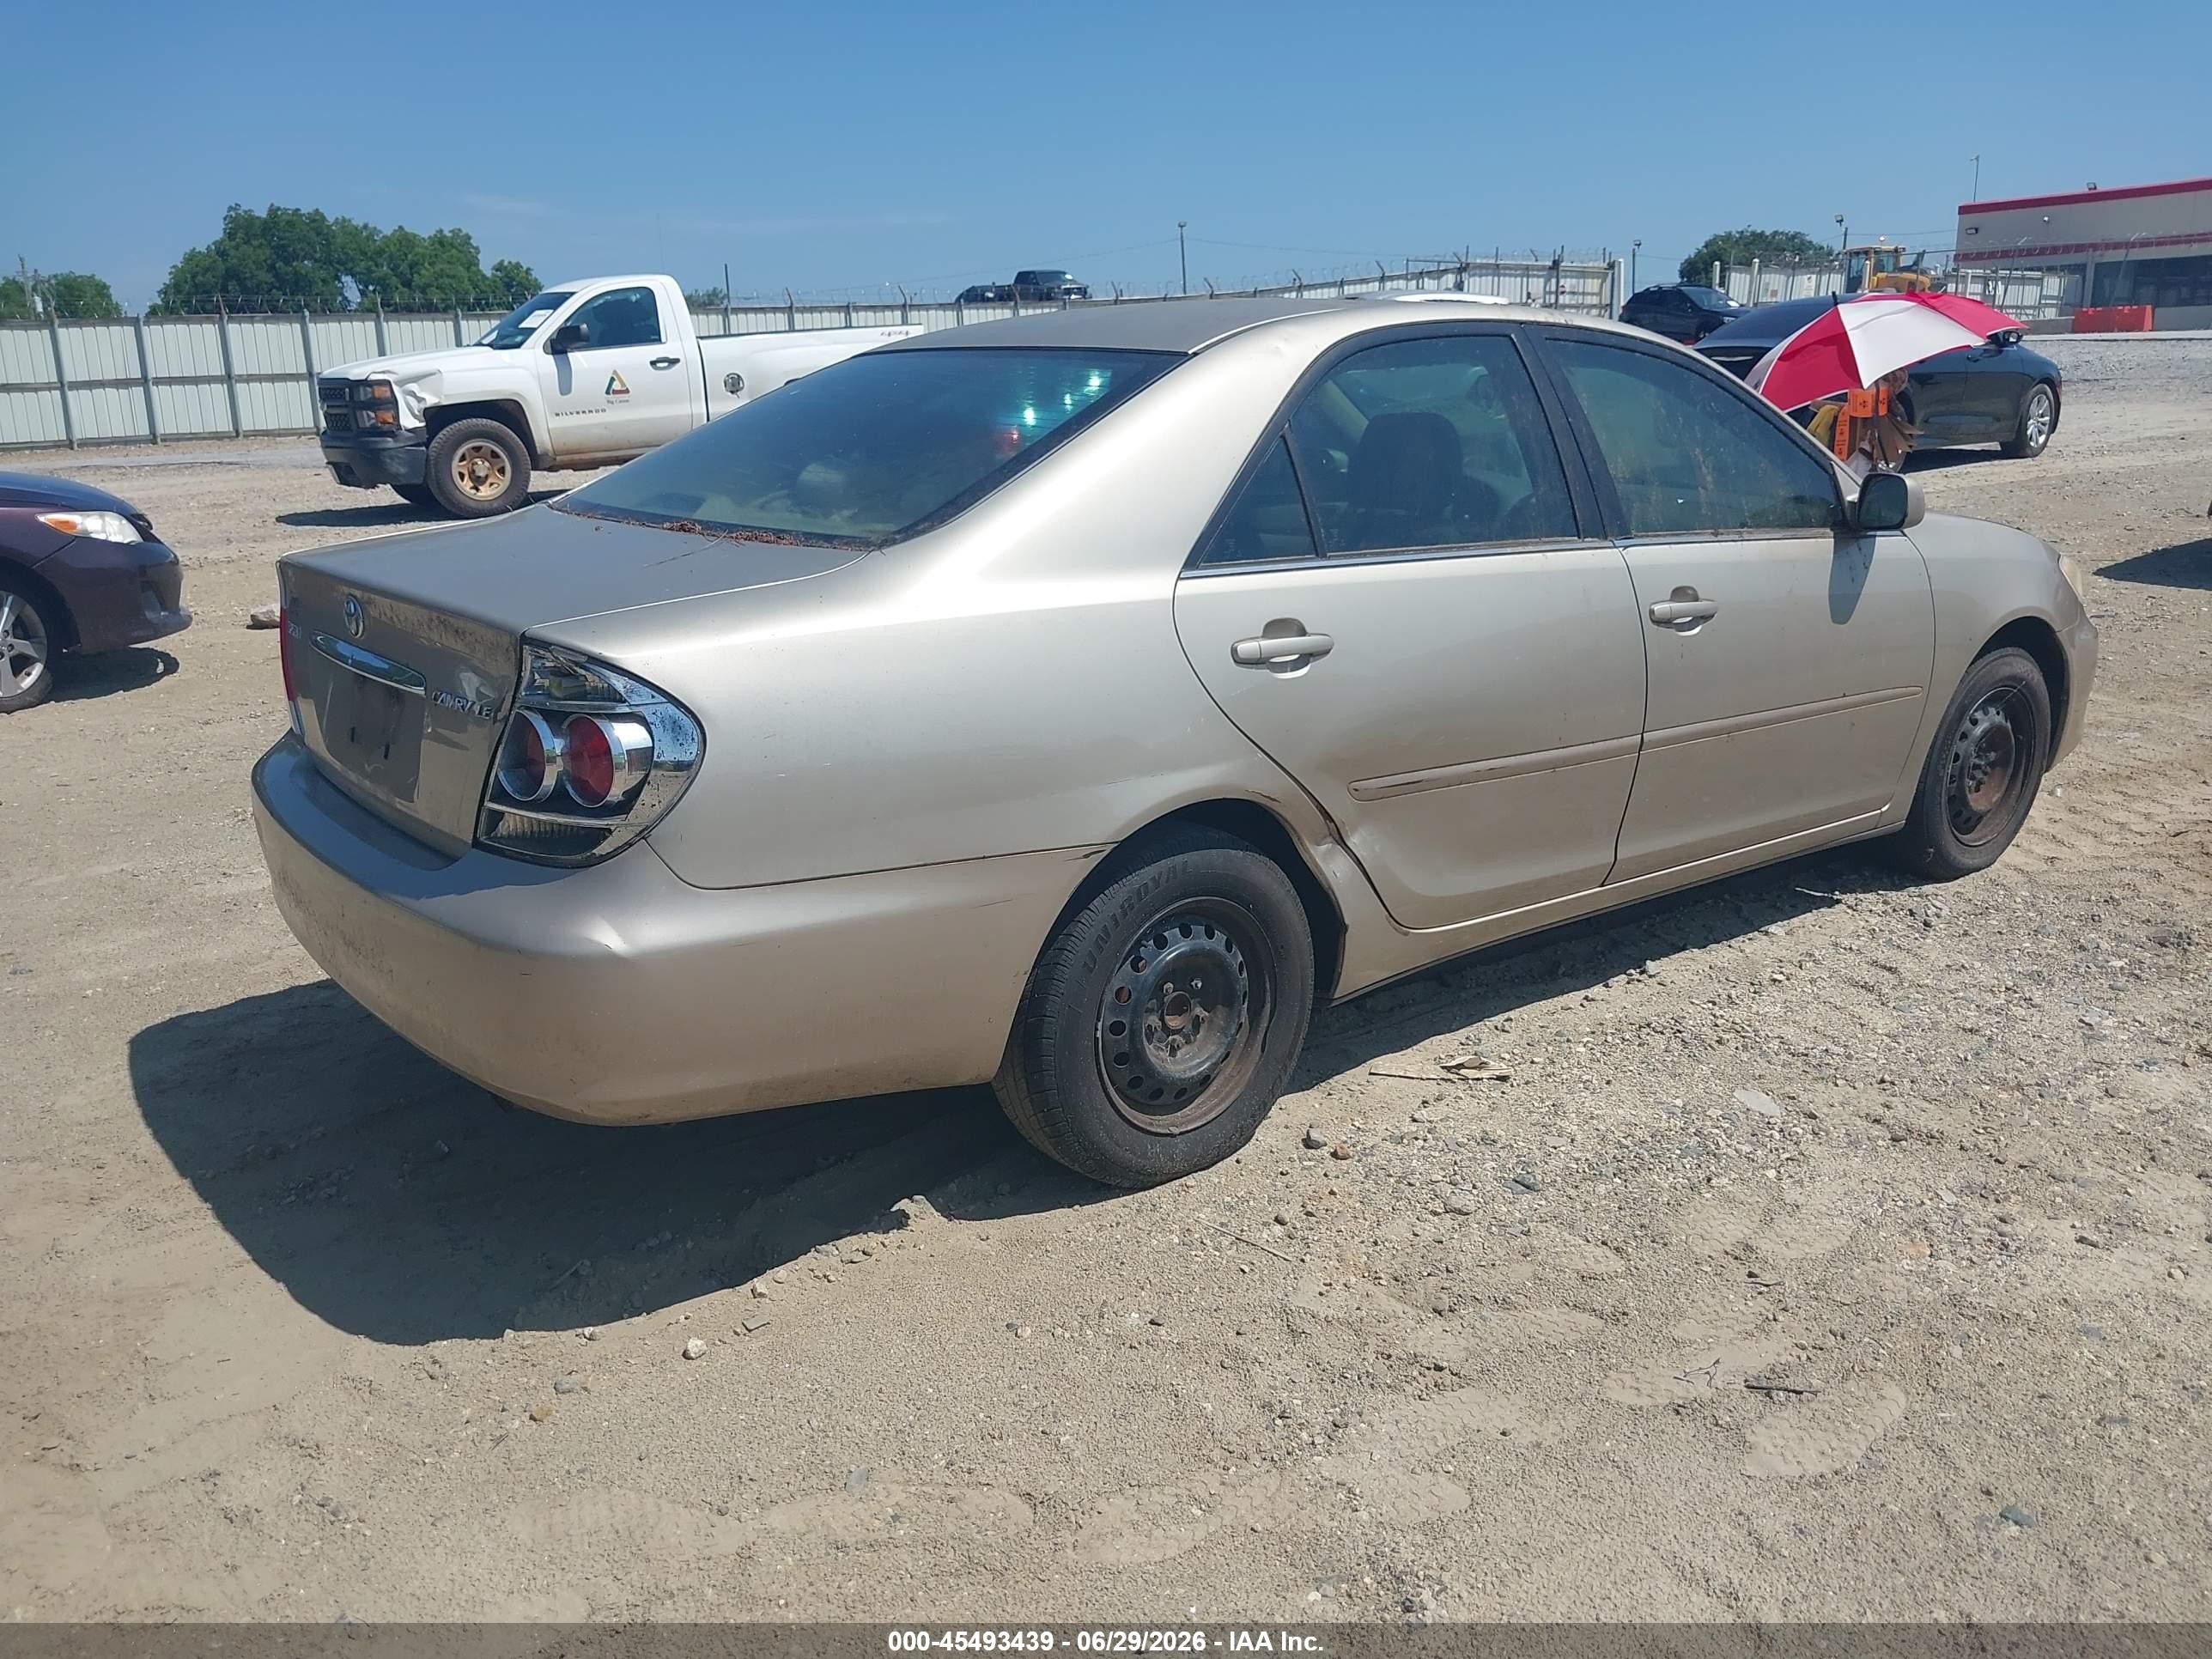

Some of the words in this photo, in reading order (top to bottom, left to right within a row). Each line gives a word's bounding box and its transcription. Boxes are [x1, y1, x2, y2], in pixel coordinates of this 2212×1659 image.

[555, 408, 606, 417] SILVERADO
[432, 691, 475, 713] CAMRY
[475, 705, 492, 720] LE
